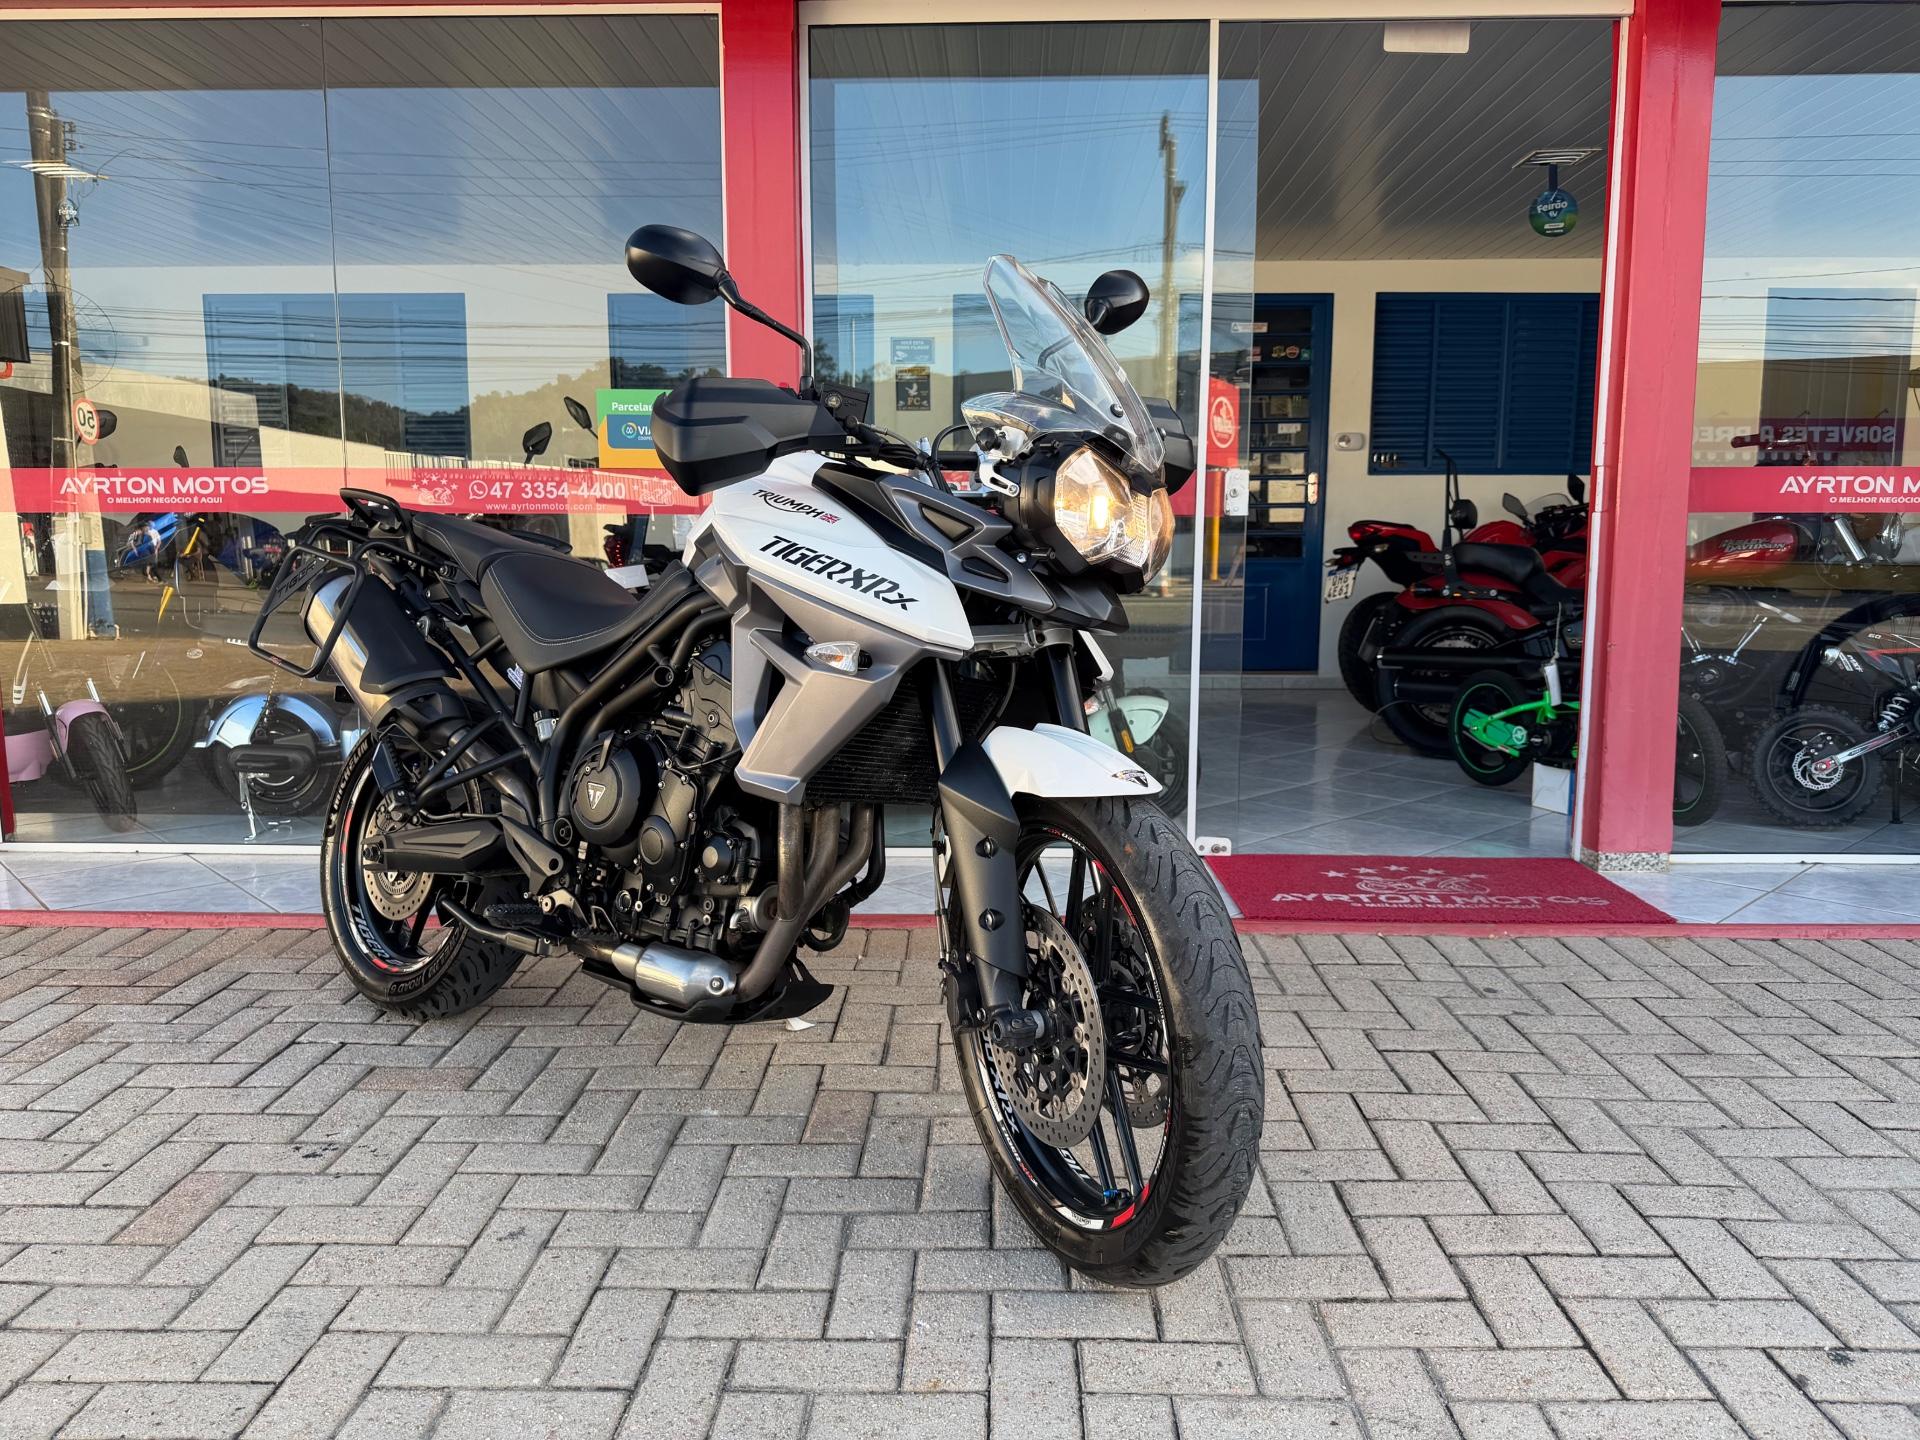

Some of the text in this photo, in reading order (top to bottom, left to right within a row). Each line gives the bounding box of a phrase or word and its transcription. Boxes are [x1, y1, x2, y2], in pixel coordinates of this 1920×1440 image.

[1537, 200, 1568, 214] Feirão
[59, 476, 270, 494] AYRTON MOTOS
[489, 481, 626, 499] 47 3354-4400
[1779, 475, 1895, 494] AYRTON
[152, 496, 192, 504] NEGÓCIO
[193, 496, 198, 504] É
[752, 489, 825, 519] TRIUMPH
[1829, 496, 1838, 504] O
[1839, 496, 1877, 504] MELHOR
[332, 738, 370, 811] MICHELIN
[1271, 893, 1611, 906] AYRTON MOTOS
[350, 903, 391, 959] TIGER
